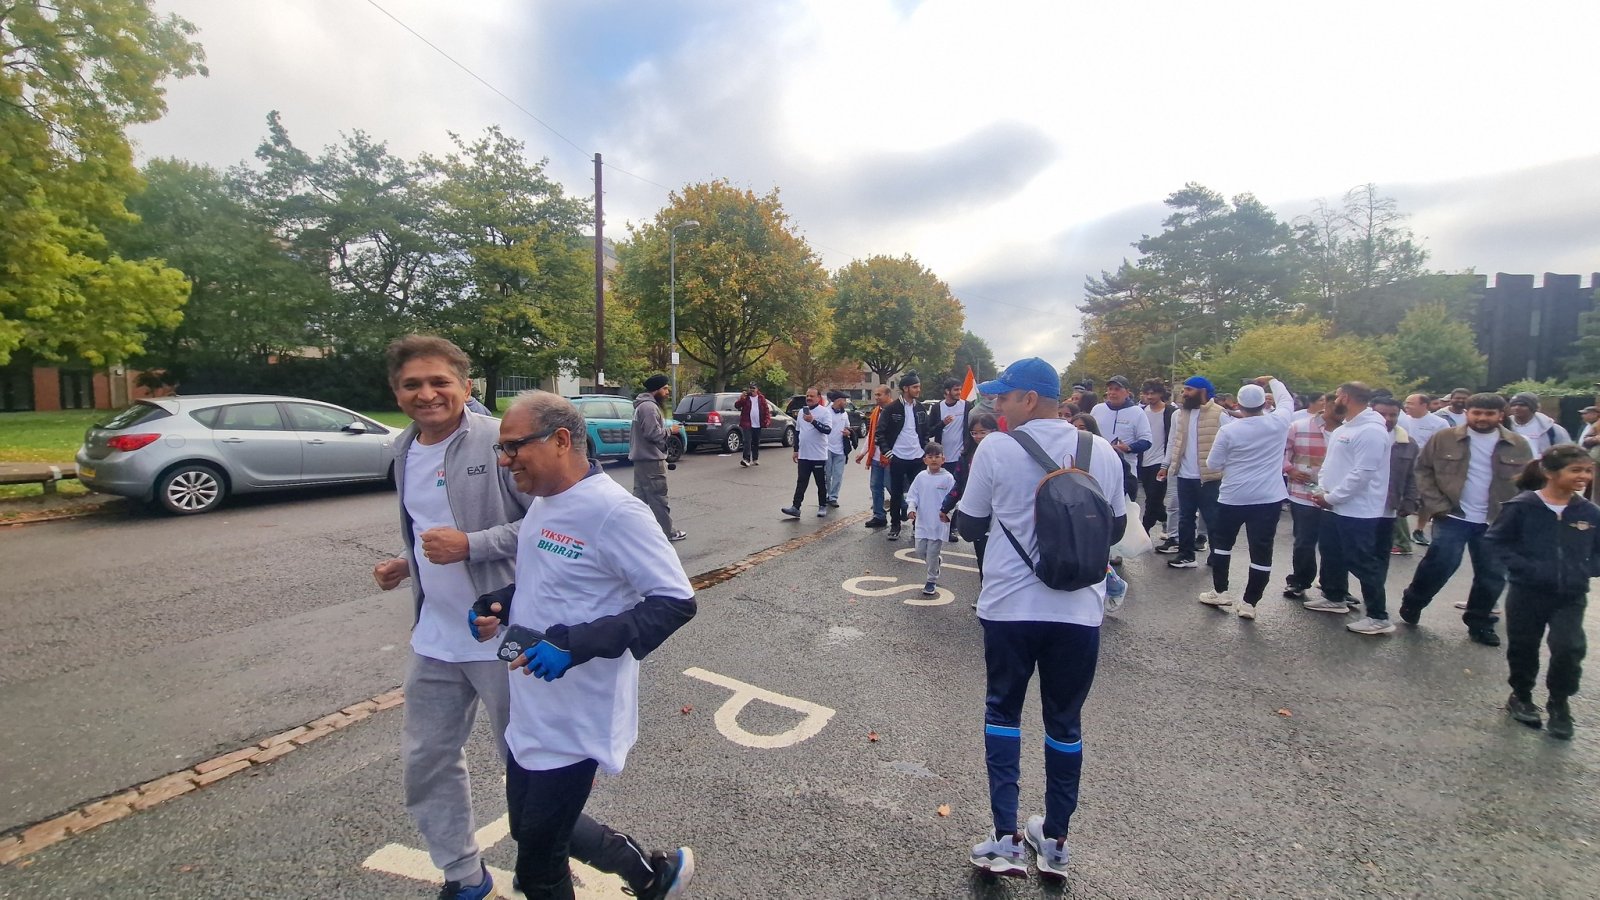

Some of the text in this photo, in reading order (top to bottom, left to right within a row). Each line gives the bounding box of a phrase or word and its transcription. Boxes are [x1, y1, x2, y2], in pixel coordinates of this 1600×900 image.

[466, 464, 487, 475] EA7
[540, 528, 573, 545] VIKSIT
[537, 539, 583, 560] BHARAT
